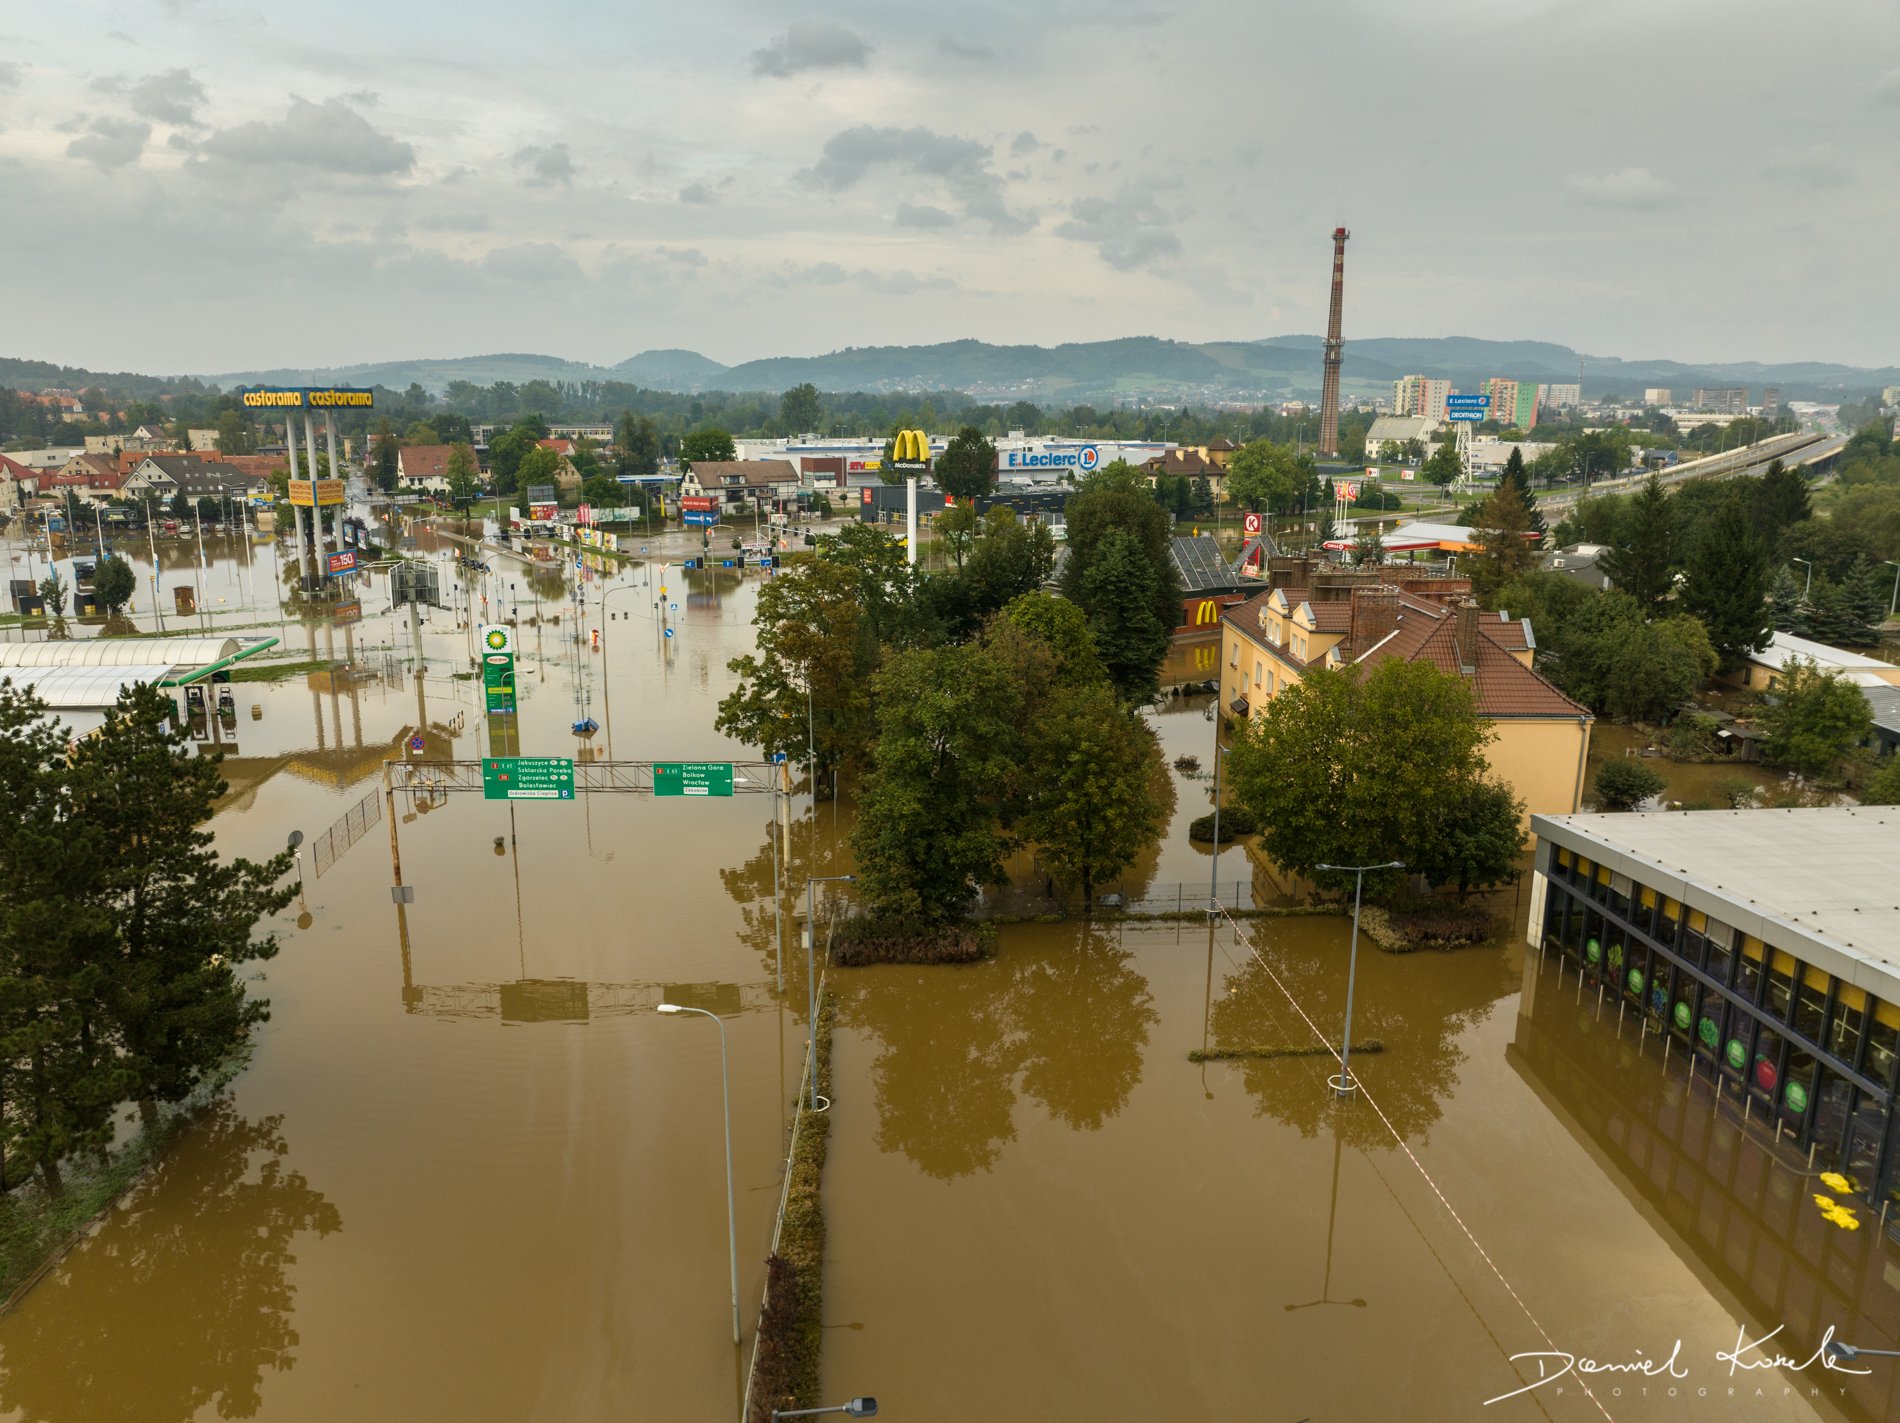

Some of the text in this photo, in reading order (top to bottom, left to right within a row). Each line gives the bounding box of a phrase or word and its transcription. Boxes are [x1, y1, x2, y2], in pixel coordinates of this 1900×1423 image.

[243, 390, 302, 406] castorama
[309, 390, 372, 406] castorama
[850, 462, 865, 470] RTV
[1008, 452, 1077, 467] E.Leclerc
[1248, 518, 1256, 530] K
